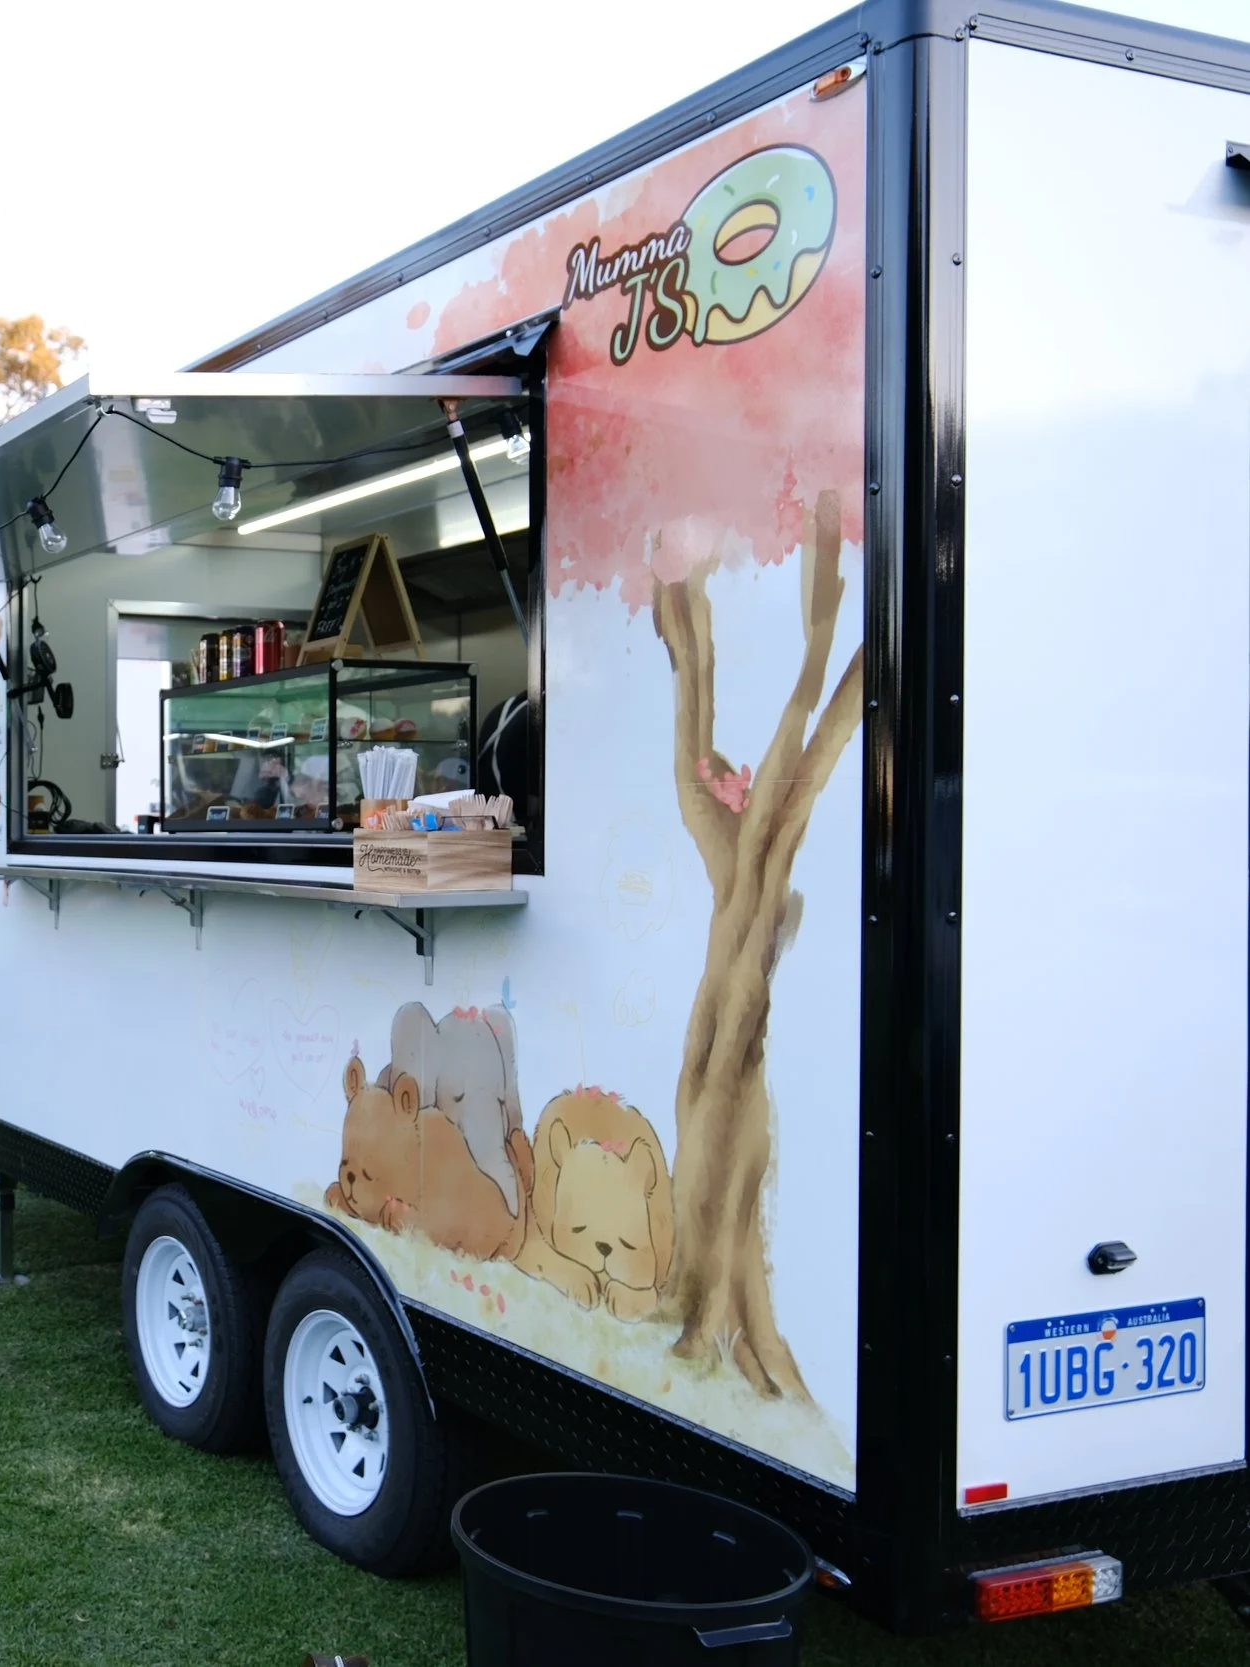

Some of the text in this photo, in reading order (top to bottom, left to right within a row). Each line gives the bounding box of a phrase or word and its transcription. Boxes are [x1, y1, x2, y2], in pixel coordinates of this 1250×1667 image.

[565, 224, 689, 305] Mumma
[359, 844, 422, 871] Homemade
[1043, 1312, 1171, 1338] WESTERN AUSTRALIA
